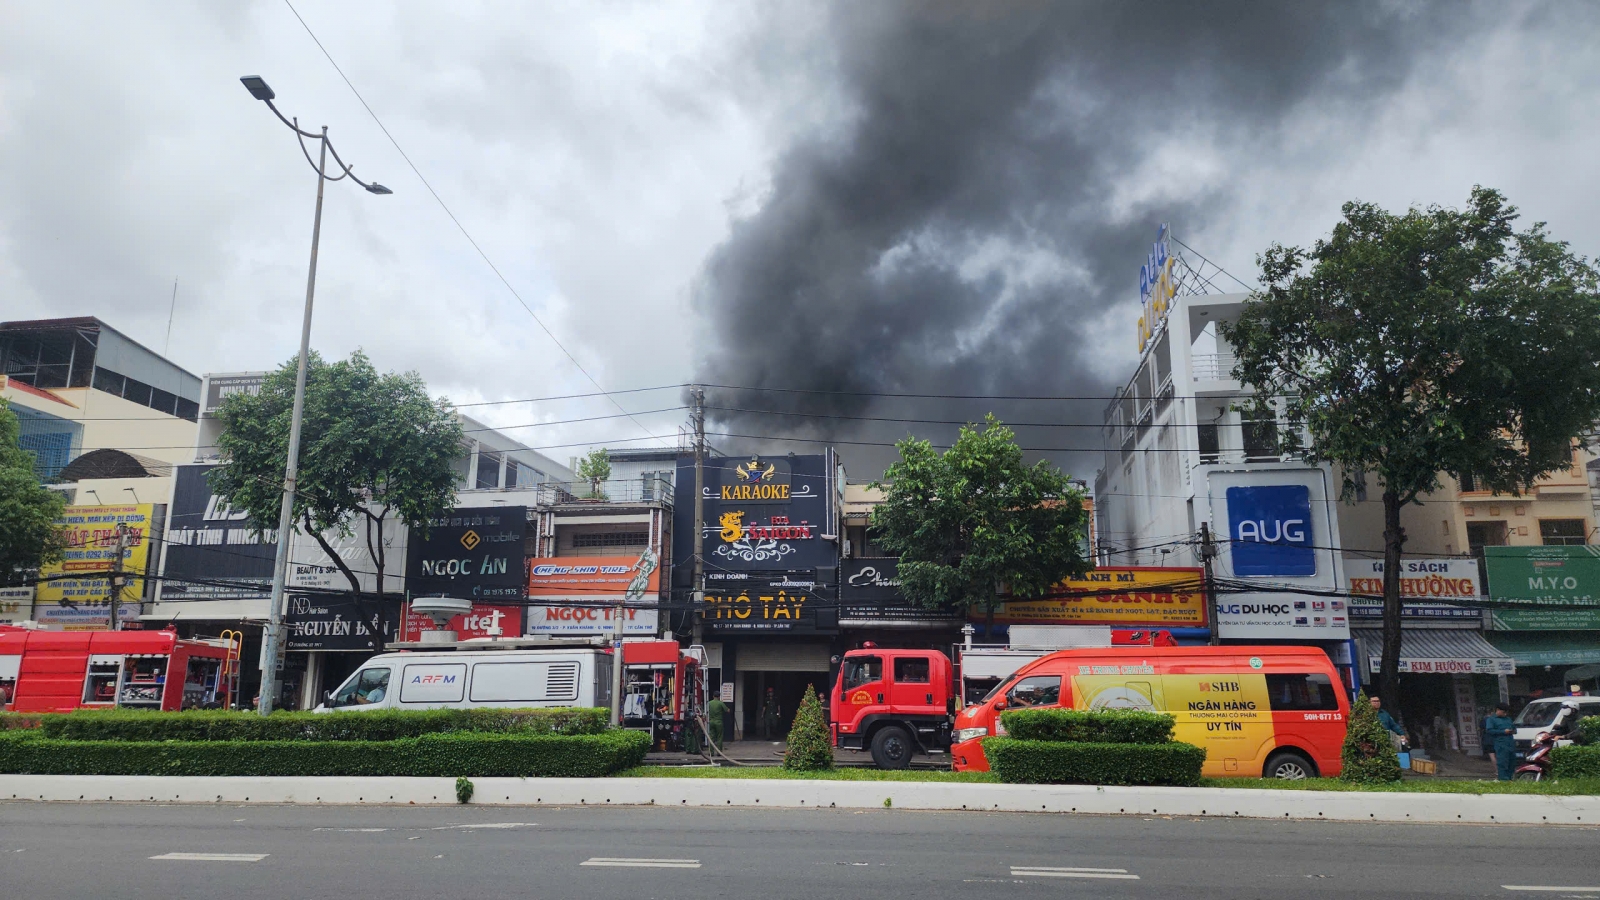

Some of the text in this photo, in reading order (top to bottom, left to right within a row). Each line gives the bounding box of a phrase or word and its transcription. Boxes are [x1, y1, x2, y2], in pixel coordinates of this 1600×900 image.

[1140, 223, 1168, 304] AUG
[721, 484, 790, 500] KARAOKE
[103, 513, 115, 522] XẾP
[771, 516, 790, 525] BIA
[168, 525, 260, 546] MÁY TÍNH MINH
[482, 530, 520, 542] mobile
[749, 526, 811, 540] SAIGON
[1238, 519, 1305, 543] AUG
[297, 566, 337, 575] BEAUTY & SPA
[421, 558, 472, 580] NGỌC
[570, 565, 597, 574] SHIN
[600, 565, 630, 574] TIRE
[1408, 561, 1448, 573] SÁCH
[1116, 570, 1135, 582] MÌ
[1350, 573, 1474, 597] KIM HƯỜNG
[1528, 576, 1578, 590] M.Y.O
[491, 588, 504, 596] 1975
[504, 588, 517, 596] 1975
[702, 589, 807, 620] PHỐ TÂY
[1216, 604, 1289, 616] AUG DU HỌC
[546, 607, 597, 624] NGỌC
[294, 614, 350, 636] NGUYỄN
[464, 613, 500, 631] ite
[1540, 652, 1562, 660] M.Y.O
[1078, 665, 1090, 675] XE
[1091, 665, 1120, 675] TRUNG
[1411, 661, 1432, 672] KIM
[1435, 658, 1471, 672] HƯỜNG
[411, 675, 456, 684] ARFM
[1212, 682, 1239, 692] SHB
[1188, 699, 1256, 710] NGÂN HÀNG
[1206, 720, 1242, 731] UY TÍN
